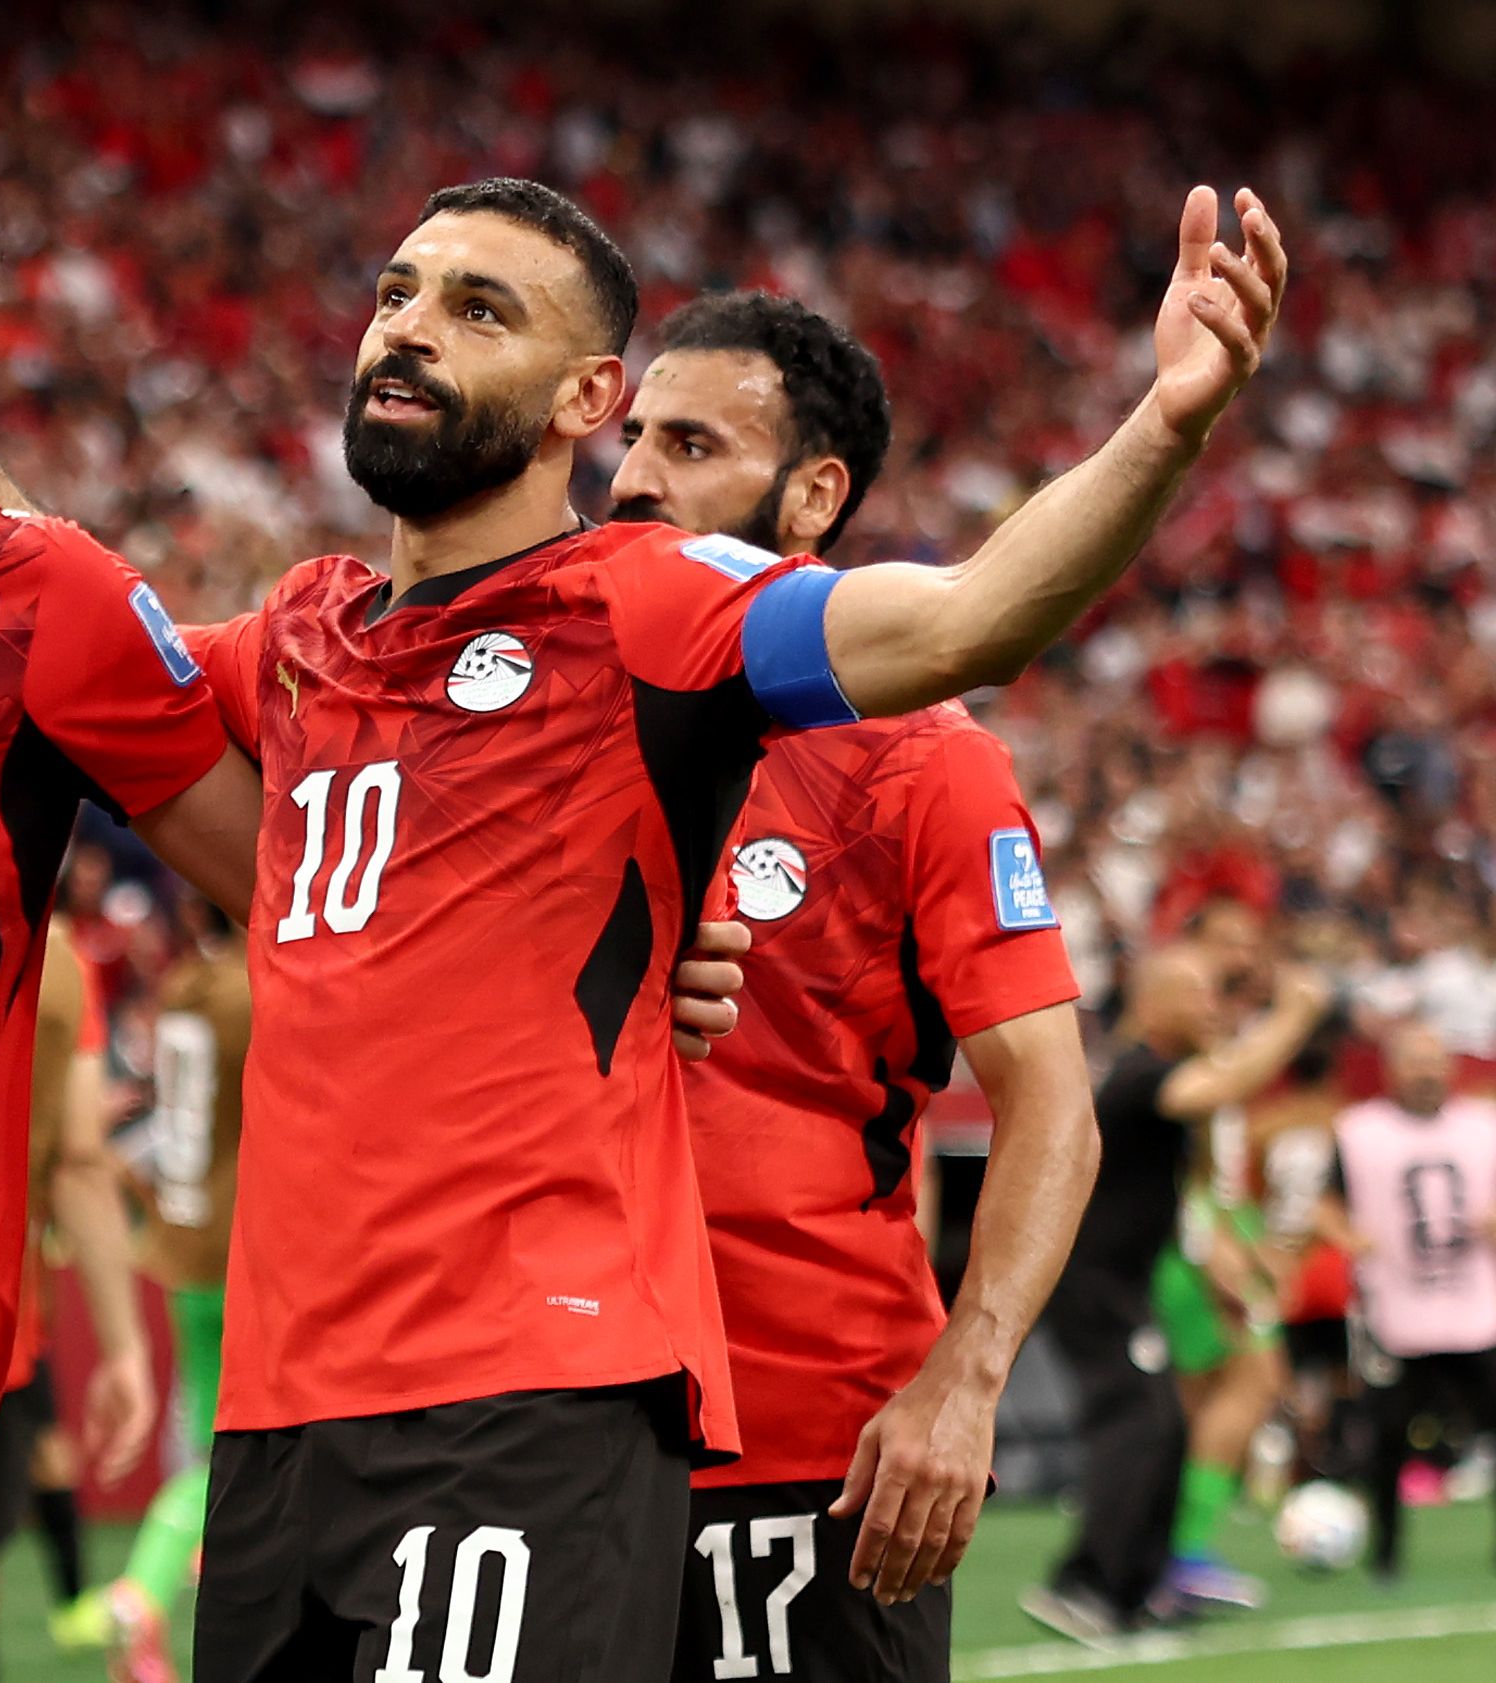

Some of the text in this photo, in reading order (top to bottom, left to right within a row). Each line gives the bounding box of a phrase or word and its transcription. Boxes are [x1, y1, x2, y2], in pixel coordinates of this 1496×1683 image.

[276, 760, 402, 944] 10
[374, 1525, 531, 1683] 10
[694, 1513, 819, 1681] 17
